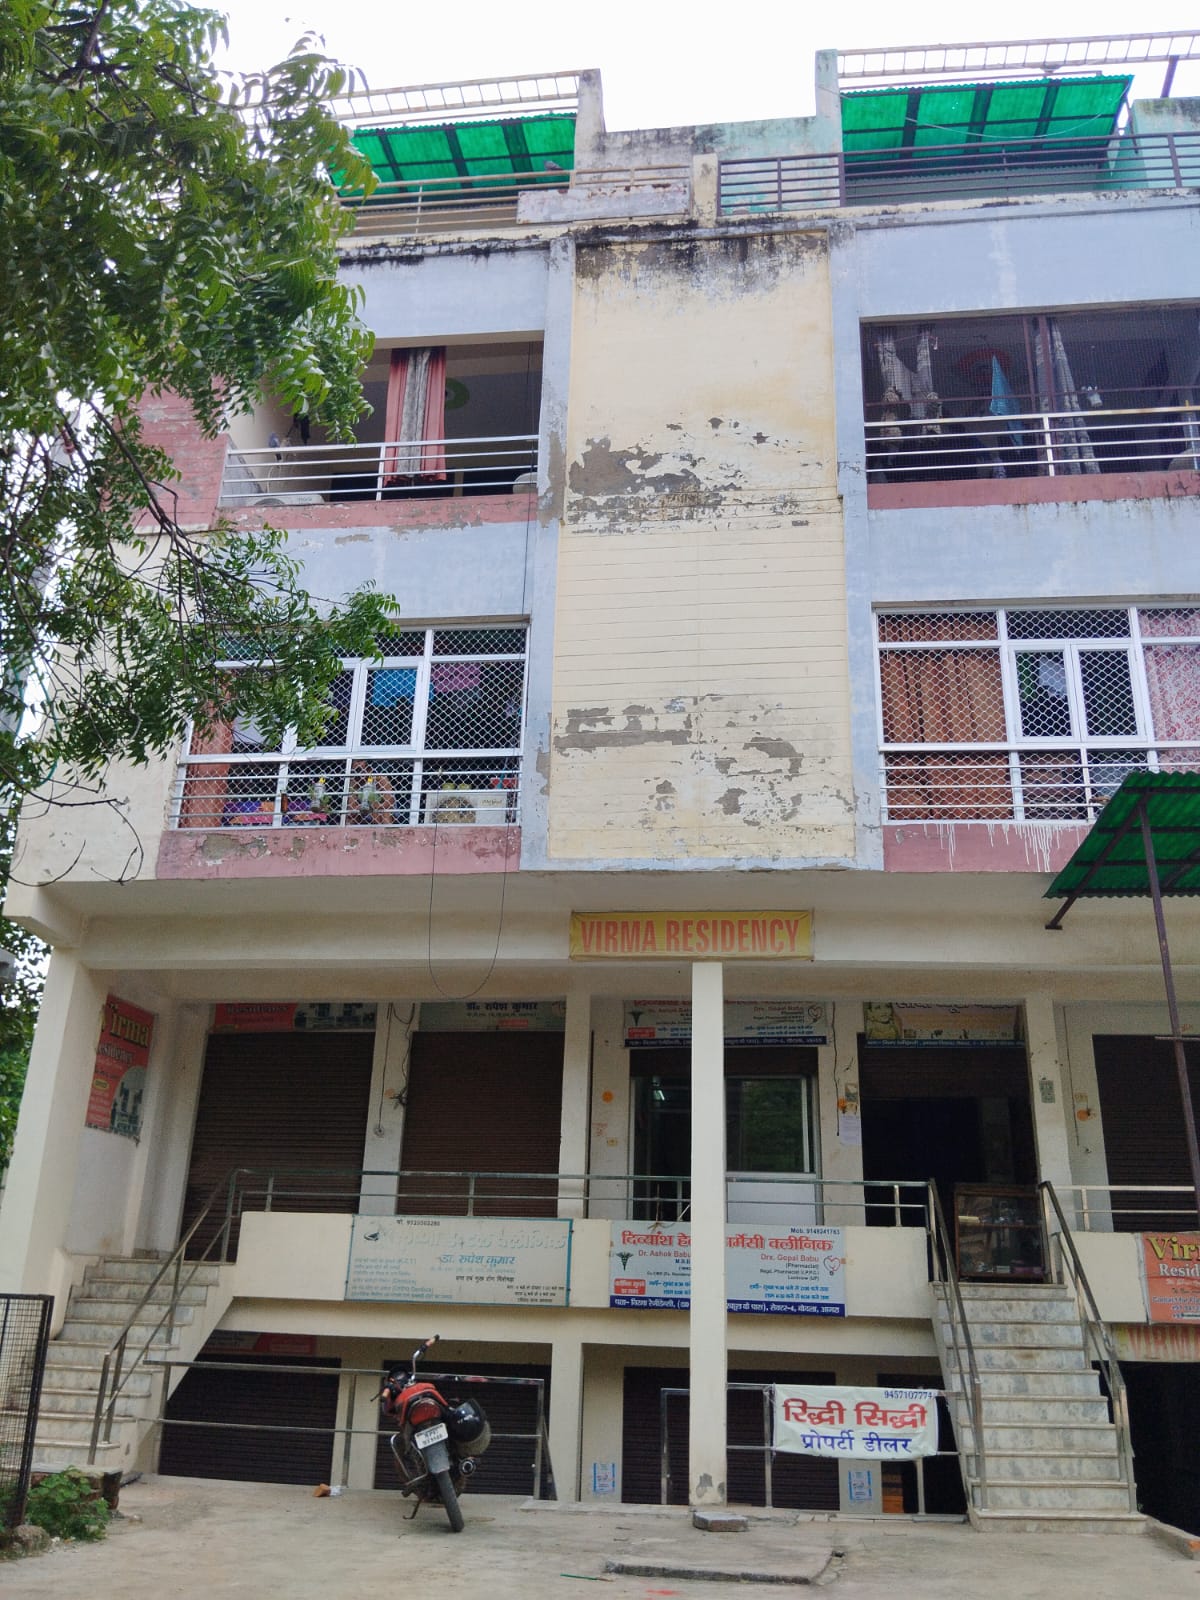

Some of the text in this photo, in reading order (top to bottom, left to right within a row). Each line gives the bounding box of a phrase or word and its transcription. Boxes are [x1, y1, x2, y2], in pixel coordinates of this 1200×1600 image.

[581, 919, 800, 953] VIRMA RESIDENCY
[677, 1233, 691, 1247] हे
[768, 1235, 833, 1251] क्लीनिक
[1147, 1235, 1200, 1261] Vir
[638, 1249, 648, 1257] Dr.
[777, 1254, 798, 1264] Gopal
[854, 1401, 927, 1429] सिद्धी
[800, 1429, 912, 1453] प्रोपर्टी डीलर
